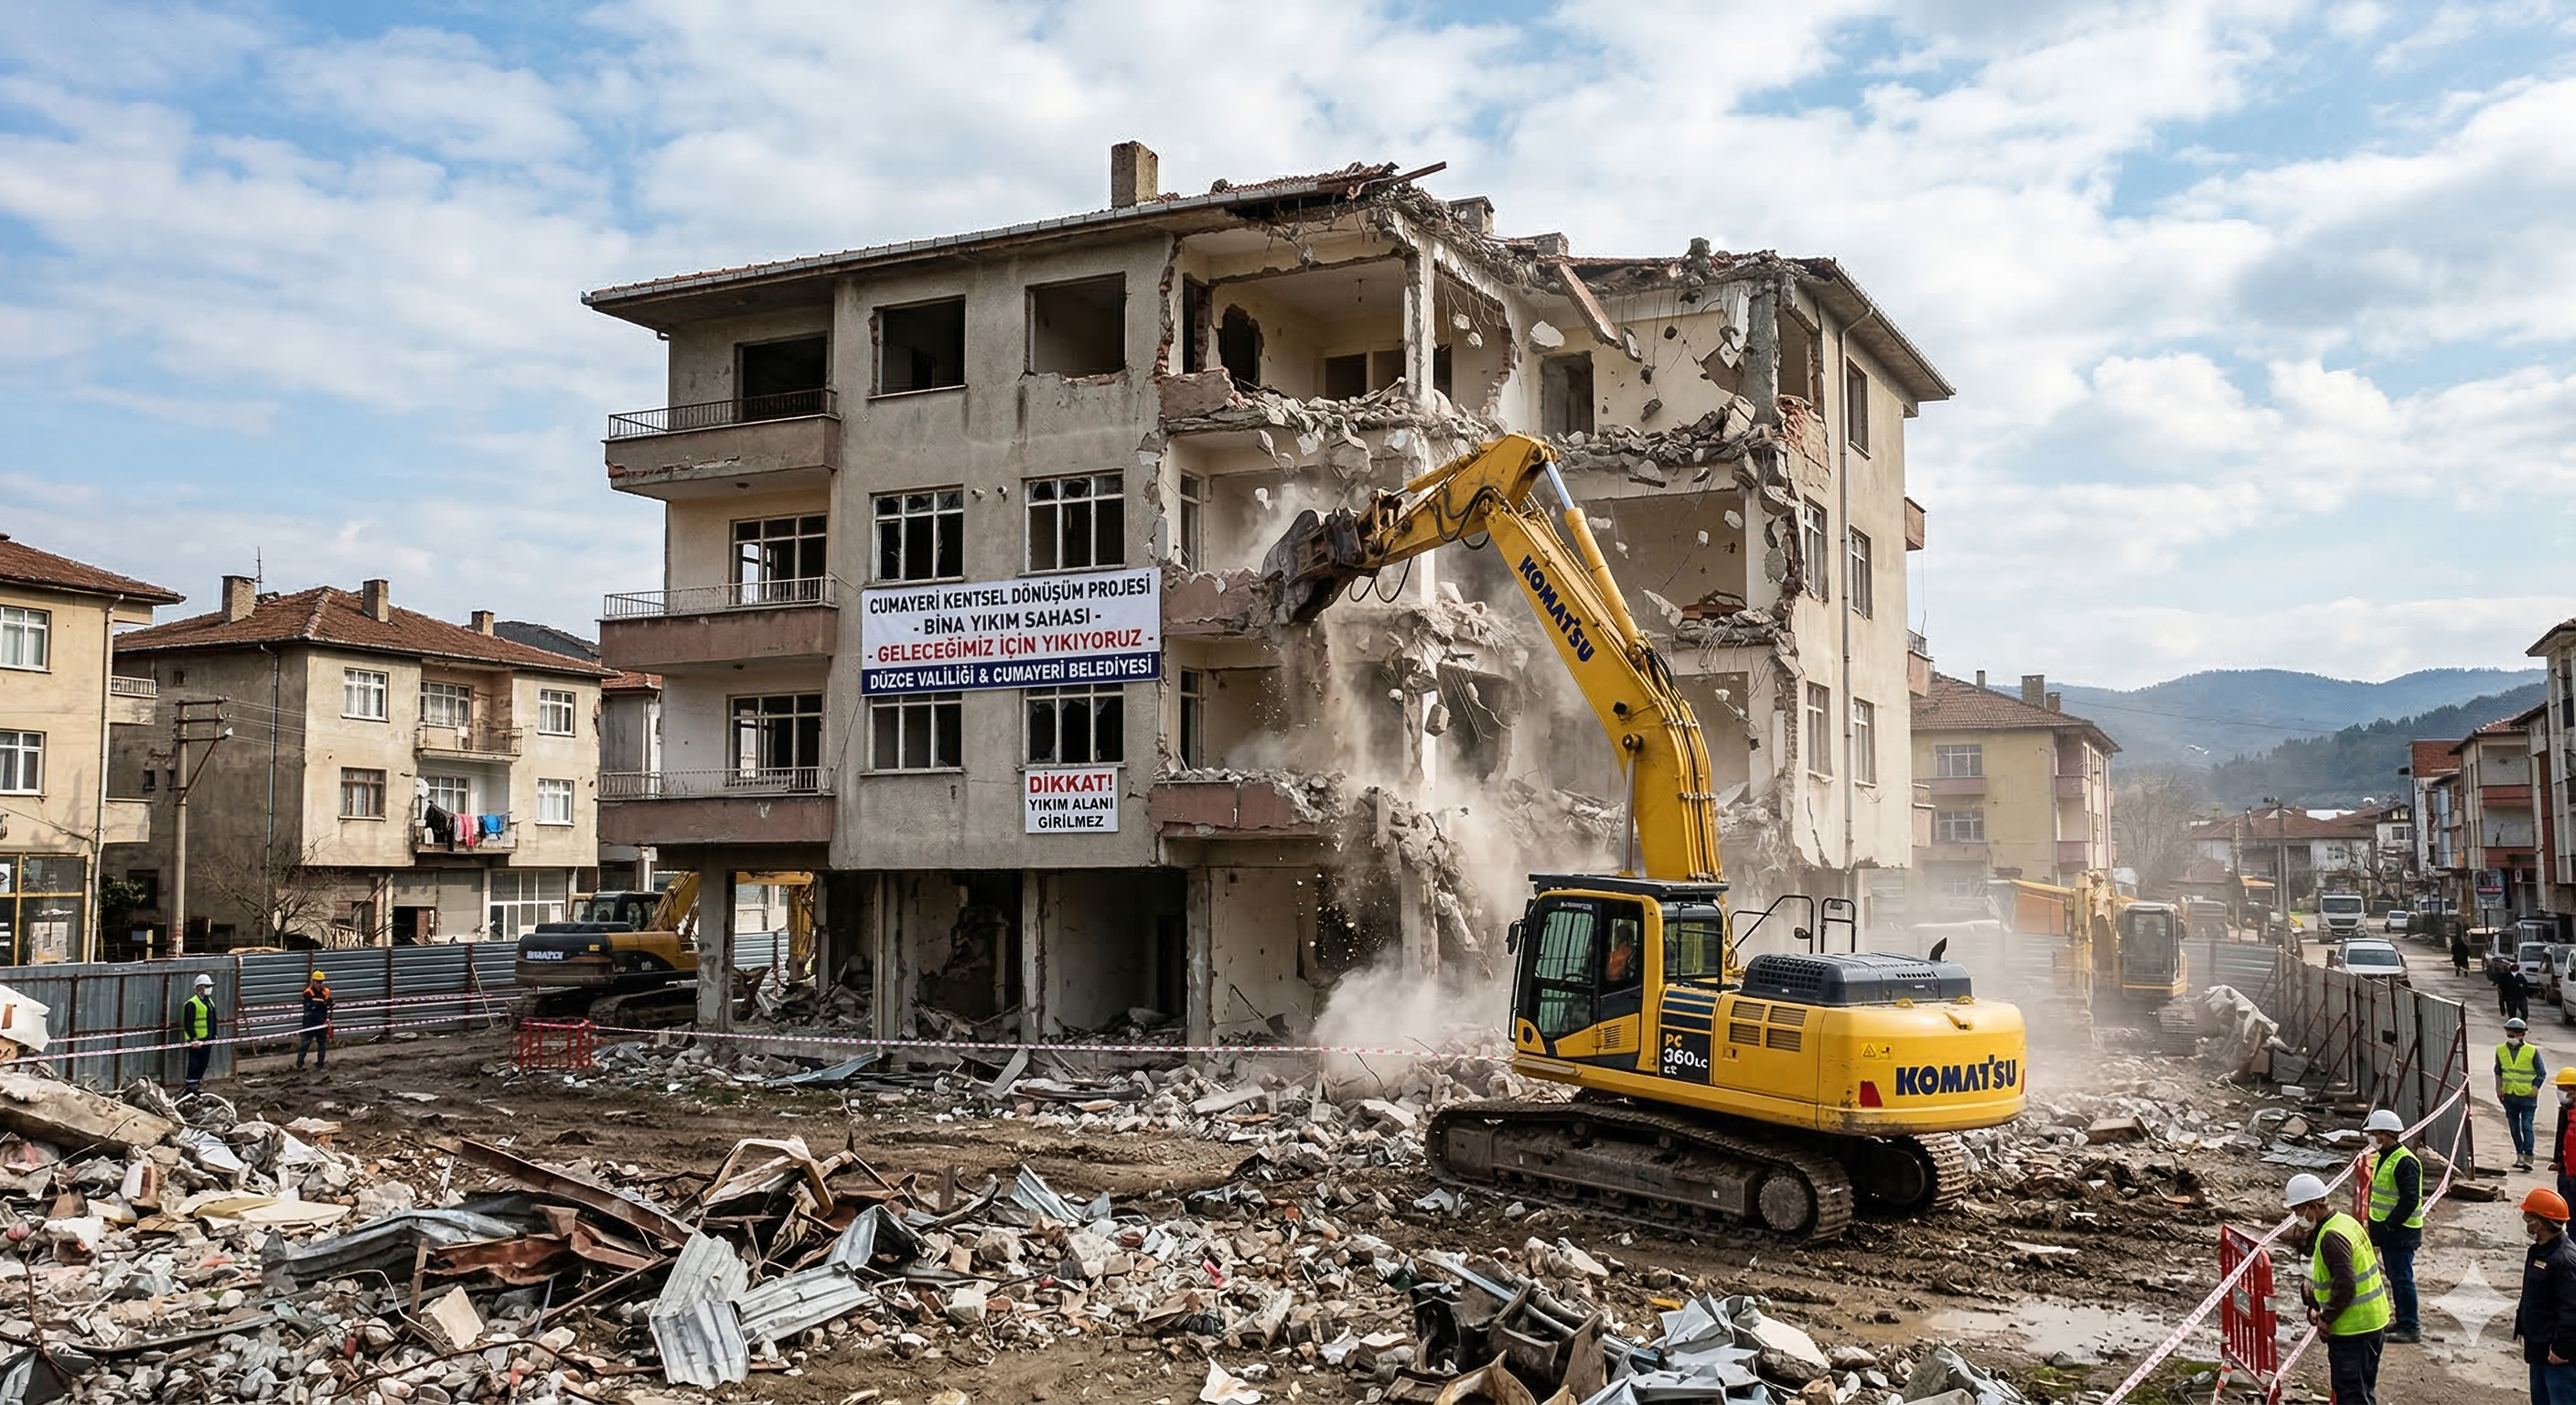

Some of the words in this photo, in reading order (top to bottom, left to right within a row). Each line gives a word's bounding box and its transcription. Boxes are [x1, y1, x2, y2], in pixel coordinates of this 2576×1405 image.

[870, 589, 939, 615] CUMAYERİ
[944, 588, 1008, 610] KENTSEL
[1012, 579, 1084, 605] DÖNÜŞÜM
[1089, 573, 1151, 598] PROJESİ
[1518, 553, 1595, 662] KOMATSU
[924, 614, 965, 635] BİNA
[971, 613, 1020, 632] YIKIM
[1025, 607, 1089, 628] SAHASI
[878, 635, 993, 662] GELECEĞİMİZ
[1000, 632, 1036, 659] İÇİN
[1042, 628, 1142, 652] YIKIYORUZ
[870, 670, 914, 689] DÜZCE
[918, 665, 974, 687] VALİLİĞİ
[979, 668, 989, 683] &
[993, 660, 1064, 682] CUMAYERİ
[1069, 653, 1152, 678] BELEDİYESİ
[1029, 771, 1113, 794] DİKKAT!
[1028, 798, 1068, 811] YIKIM
[1072, 797, 1113, 810] ALANI
[1038, 813, 1104, 829] GİRİLMEZ
[1665, 1033, 1682, 1048] PC
[1663, 1047, 1708, 1068] 360LC
[1895, 1054, 2016, 1096] KOMATSU
